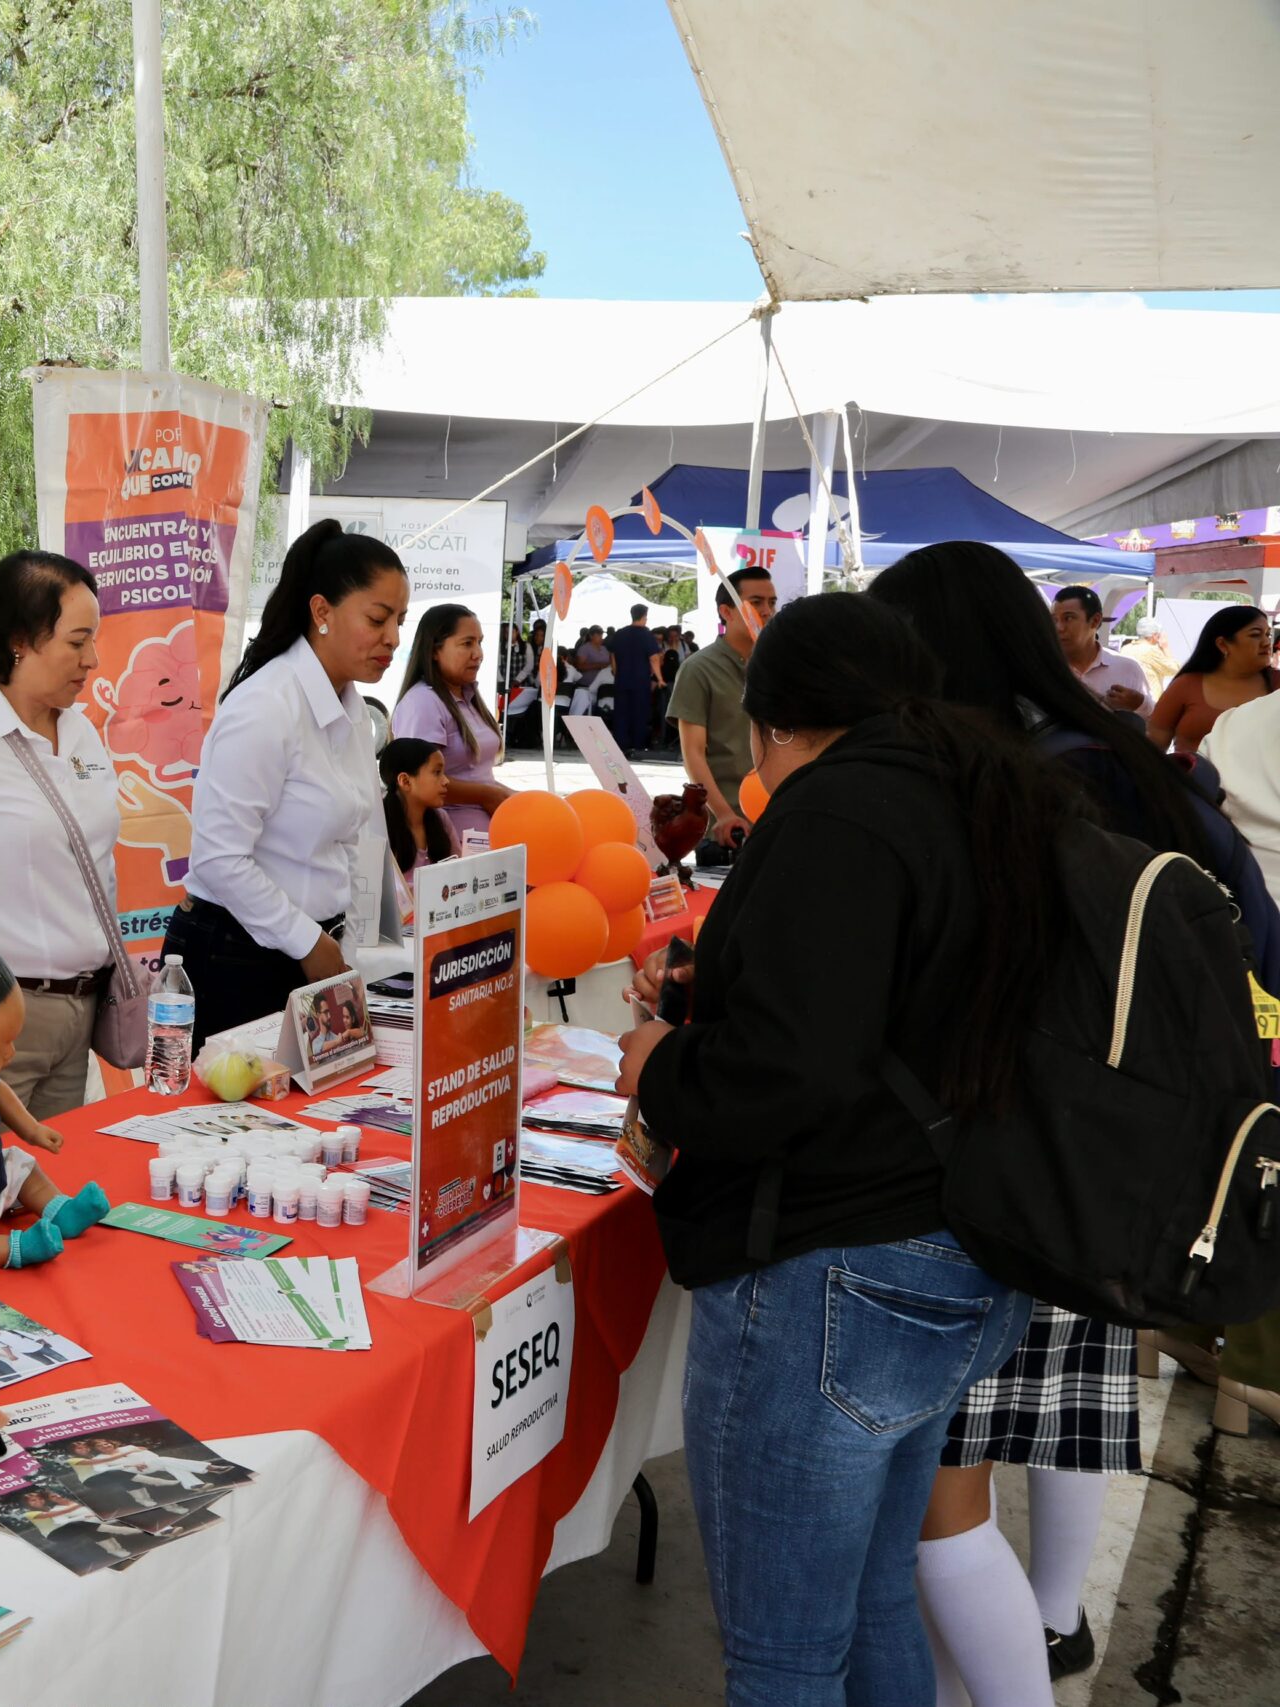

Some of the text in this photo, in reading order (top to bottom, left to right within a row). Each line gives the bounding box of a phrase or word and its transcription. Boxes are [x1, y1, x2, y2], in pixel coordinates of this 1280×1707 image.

[121, 474, 151, 500] QUE
[384, 532, 467, 552] MOSCATI
[88, 543, 165, 568] EQUILIBRIO
[738, 544, 776, 569] DIF
[95, 564, 169, 590] SERVICIOS
[413, 563, 443, 575] clave
[445, 567, 460, 575] en
[414, 579, 465, 592] próstata.
[435, 941, 512, 984] JURISDICCIÓN
[449, 974, 514, 1011] SANITARIA NO.2
[1257, 1014, 1280, 1036] 97
[427, 1045, 515, 1102] STAND DE SALUD
[431, 1074, 511, 1130] REPRODUCTIVA
[490, 1321, 561, 1410] SESEQ
[32, 1414, 152, 1444] ¿AHORA QUÉ HAGO?
[36, 1412, 131, 1435] Tengo una Bolita
[486, 1392, 559, 1461] SALUD REPRODUCTIVA
